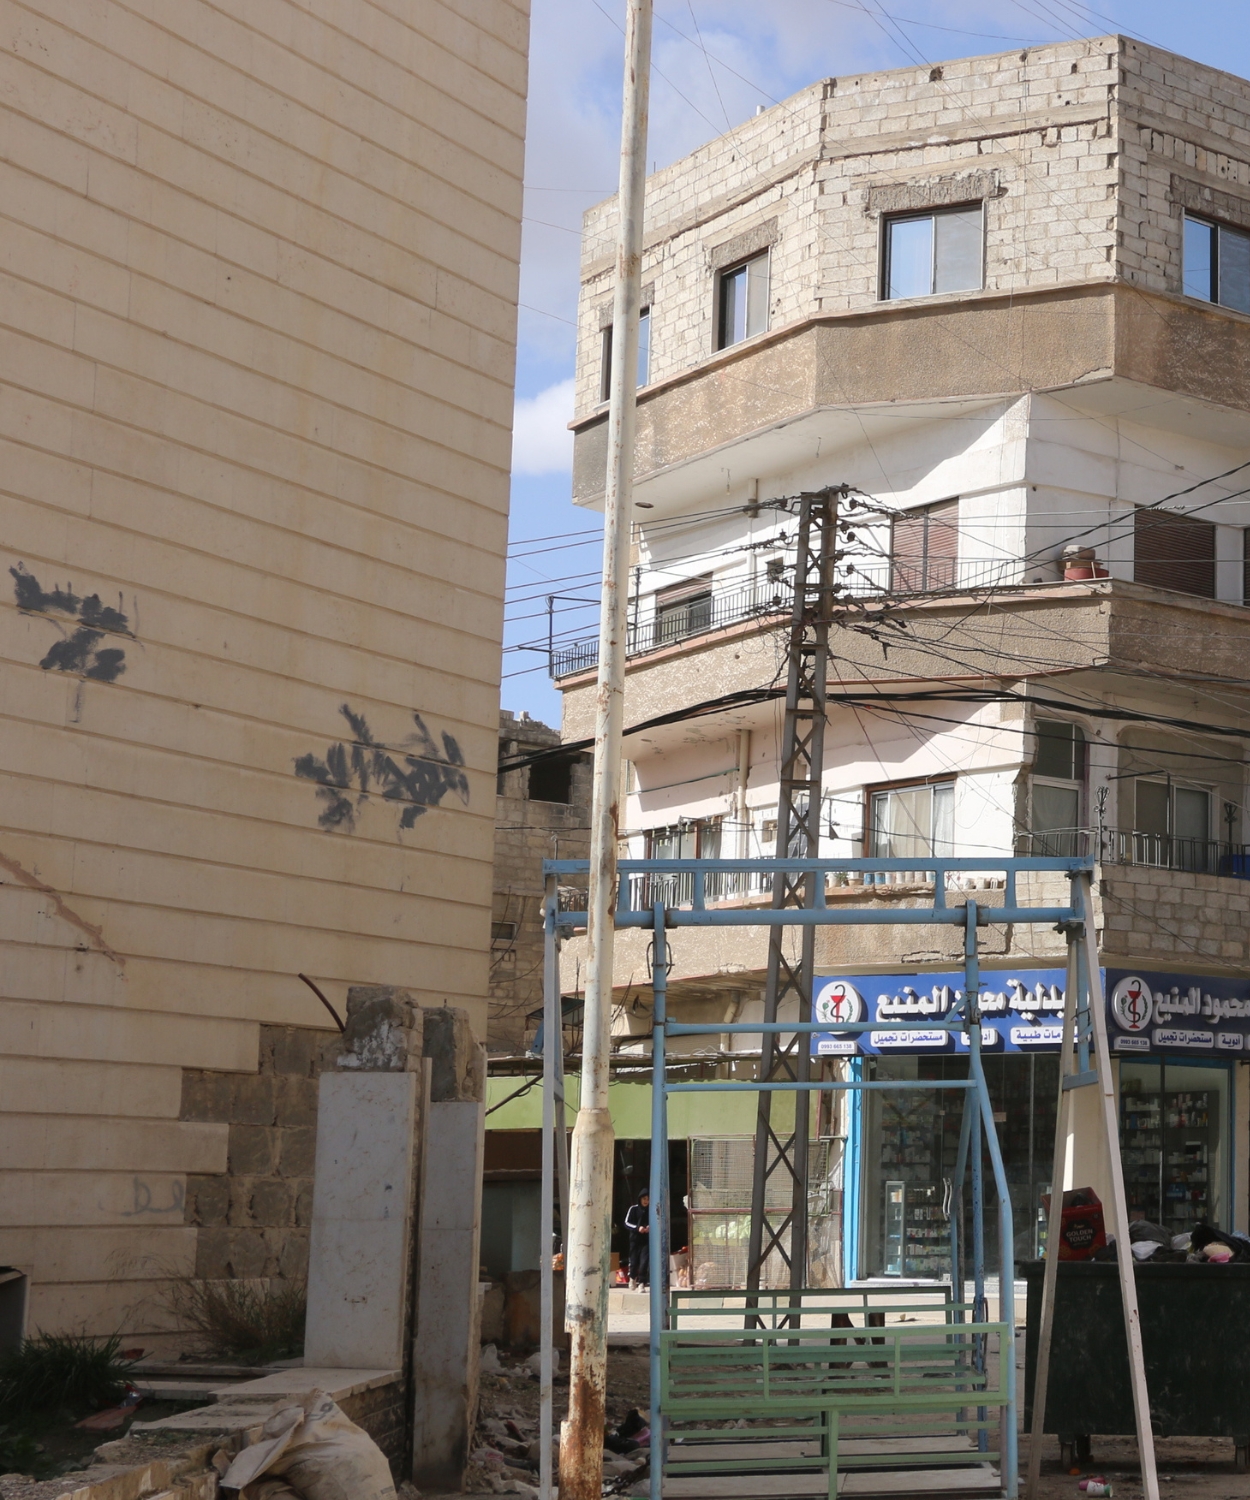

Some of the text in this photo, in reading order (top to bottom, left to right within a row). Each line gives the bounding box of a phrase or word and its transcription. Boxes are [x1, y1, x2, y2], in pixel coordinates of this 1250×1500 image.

[1152, 986, 1201, 1024] المنيع
[1201, 993, 1250, 1024] محمود
[873, 1031, 943, 1045] مستحضرات تجميل
[1016, 1029, 1041, 1042] طبية
[1158, 1032, 1212, 1044] مستحضرات تجميل
[1222, 1034, 1240, 1047] أدوية
[1066, 1228, 1093, 1237] GOLDEN
